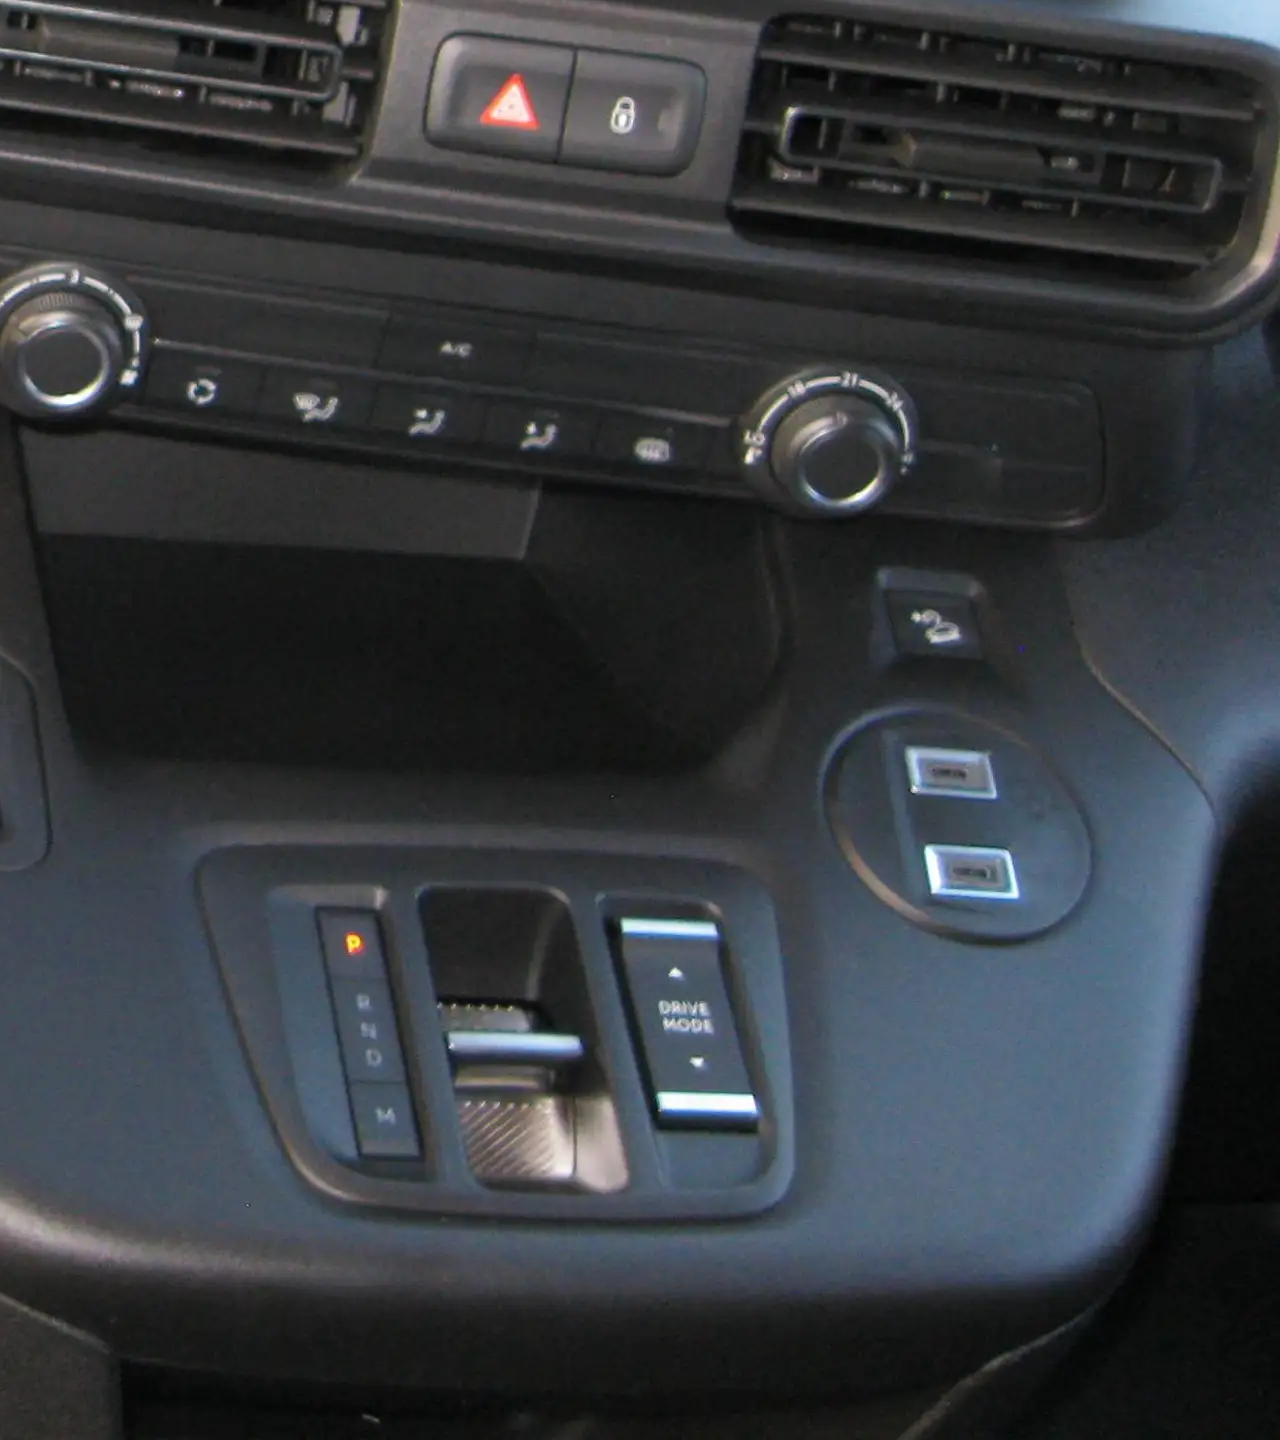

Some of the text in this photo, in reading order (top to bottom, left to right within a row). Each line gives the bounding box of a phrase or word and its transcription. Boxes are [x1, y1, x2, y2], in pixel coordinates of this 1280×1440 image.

[438, 339, 474, 359] A/C
[841, 370, 860, 389] 21
[344, 932, 365, 955] P
[356, 993, 371, 1011] R
[658, 999, 711, 1017] DRIVE
[360, 1021, 378, 1040] N
[662, 1017, 715, 1035] MODE
[365, 1047, 383, 1068] D
[375, 1106, 397, 1126] M
